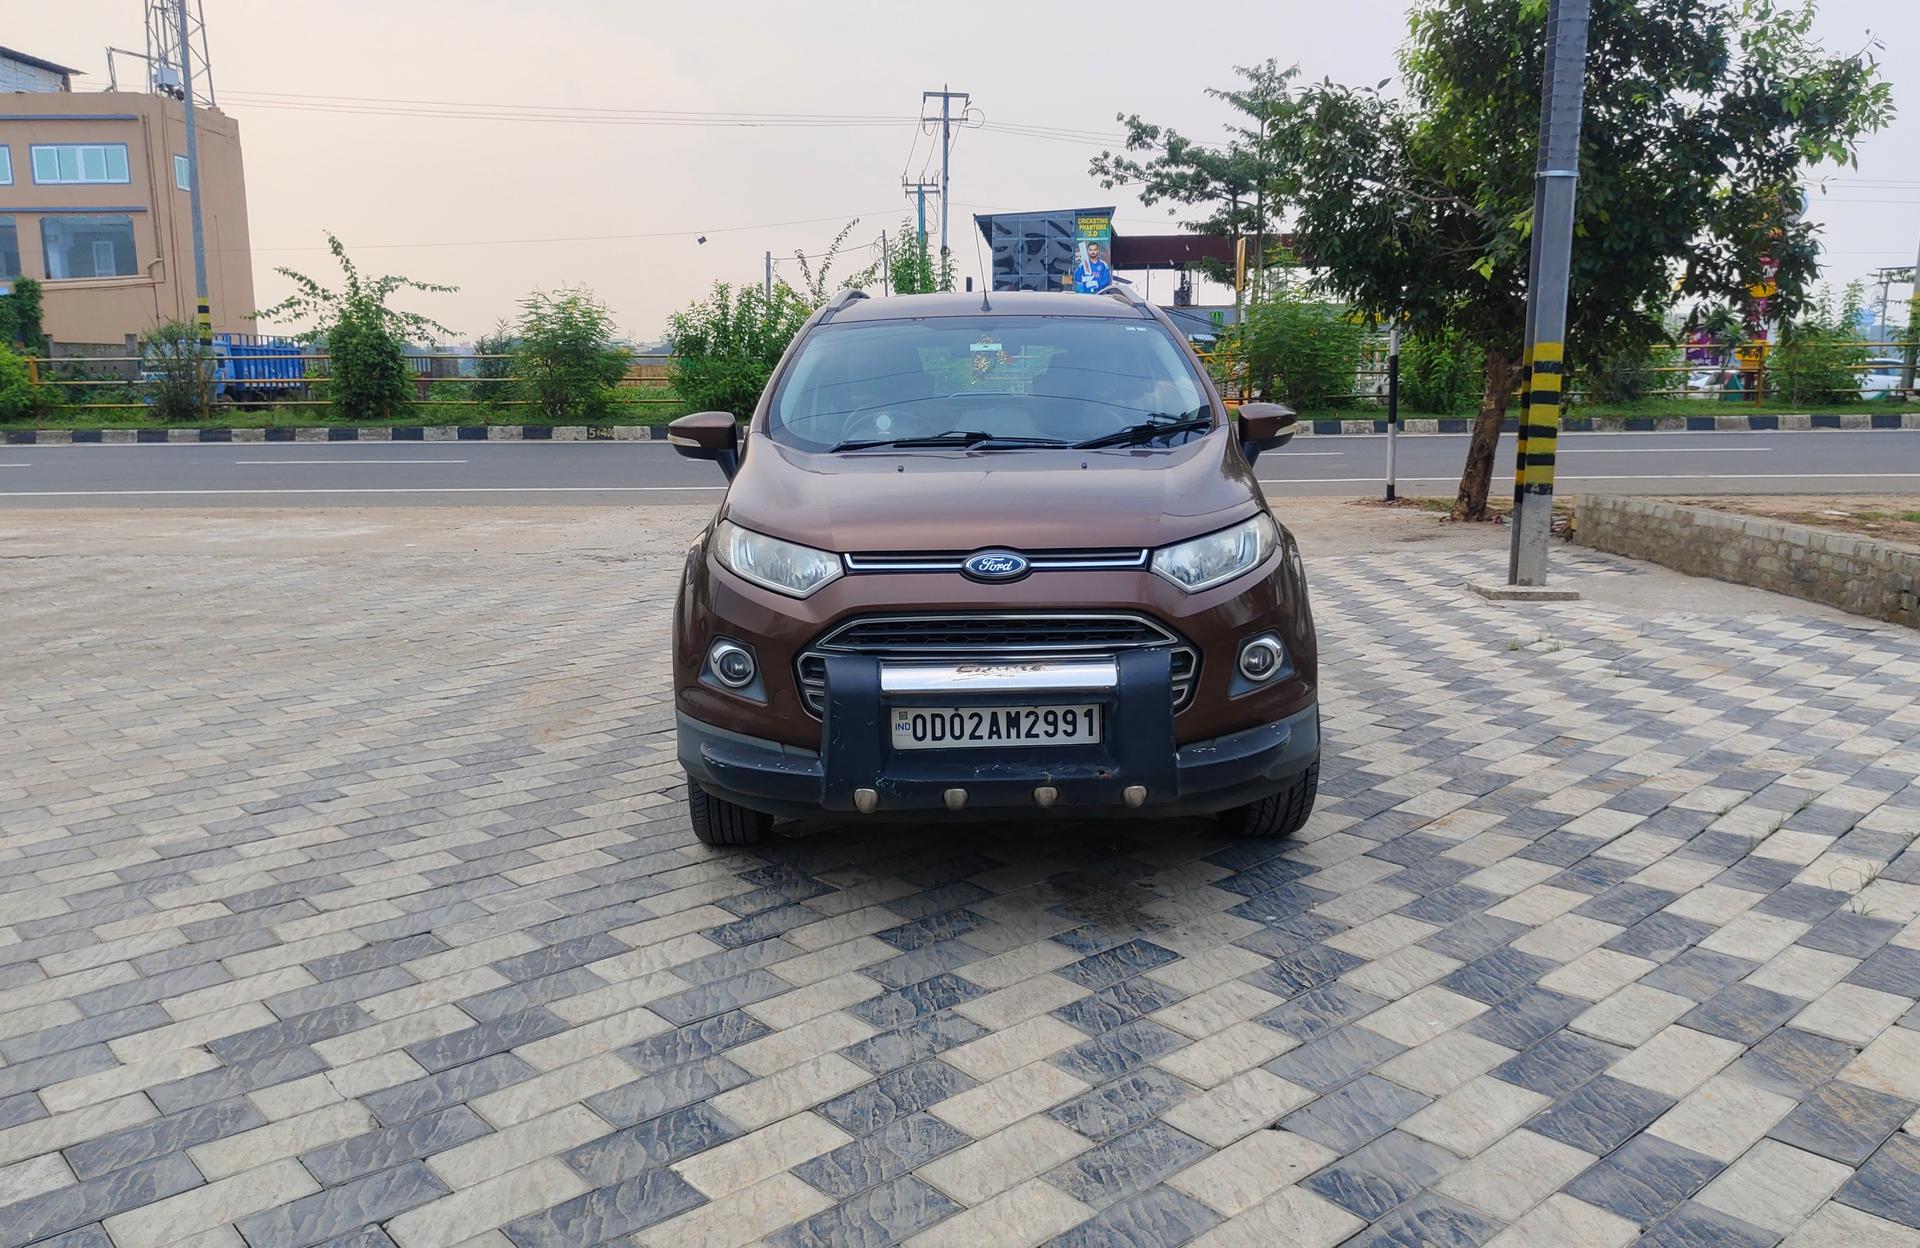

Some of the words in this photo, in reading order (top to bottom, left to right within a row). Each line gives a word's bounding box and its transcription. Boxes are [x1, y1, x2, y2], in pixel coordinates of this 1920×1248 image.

[978, 556, 1013, 572] Ford
[895, 722, 911, 731] IND
[912, 708, 1093, 742] OD02AM2991
